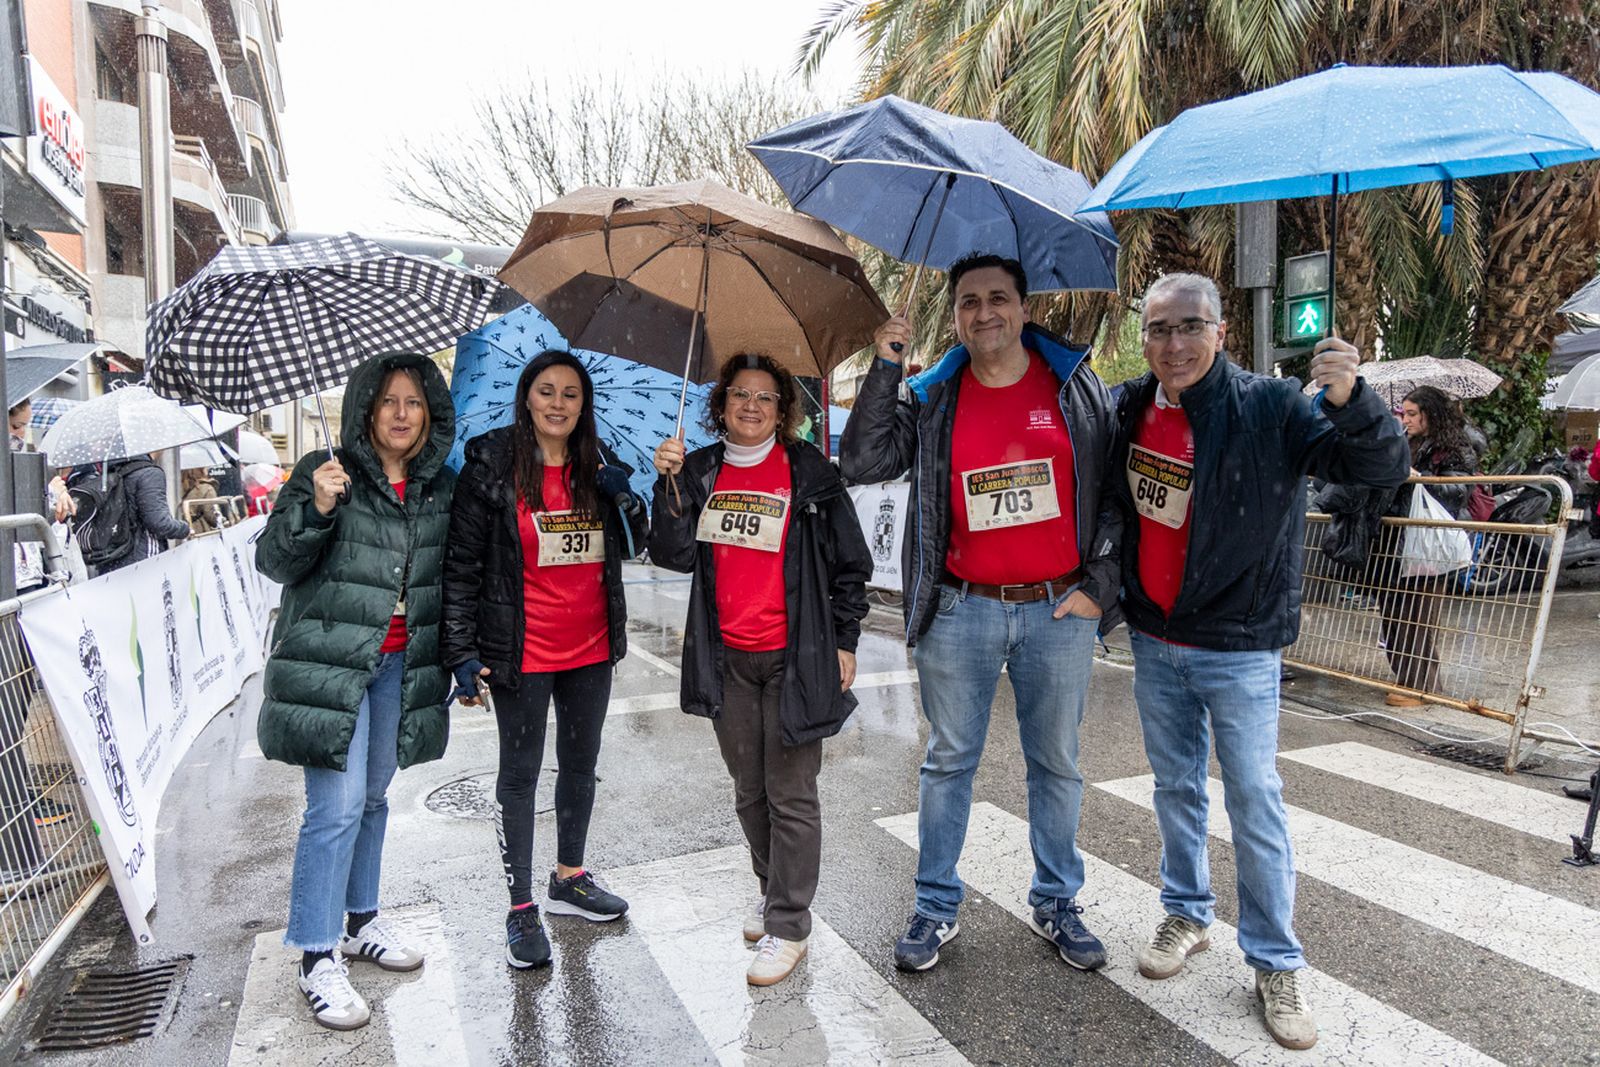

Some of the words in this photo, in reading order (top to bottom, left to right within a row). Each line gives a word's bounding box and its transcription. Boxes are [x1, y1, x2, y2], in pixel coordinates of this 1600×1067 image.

[971, 473, 984, 484] IES
[985, 471, 1000, 480] San
[1001, 468, 1020, 479] Juan
[971, 484, 978, 494] V
[978, 479, 1011, 493] CARRERA
[1014, 473, 1048, 488] POPULAR
[741, 494, 758, 503] Juan
[989, 489, 1034, 516] 703
[1137, 477, 1169, 510] 648
[711, 500, 716, 508] V
[717, 501, 747, 511] CARRERA
[749, 503, 780, 516] POPULAR
[548, 523, 576, 531] CARRERA
[721, 512, 762, 537] 649
[562, 532, 590, 554] 331
